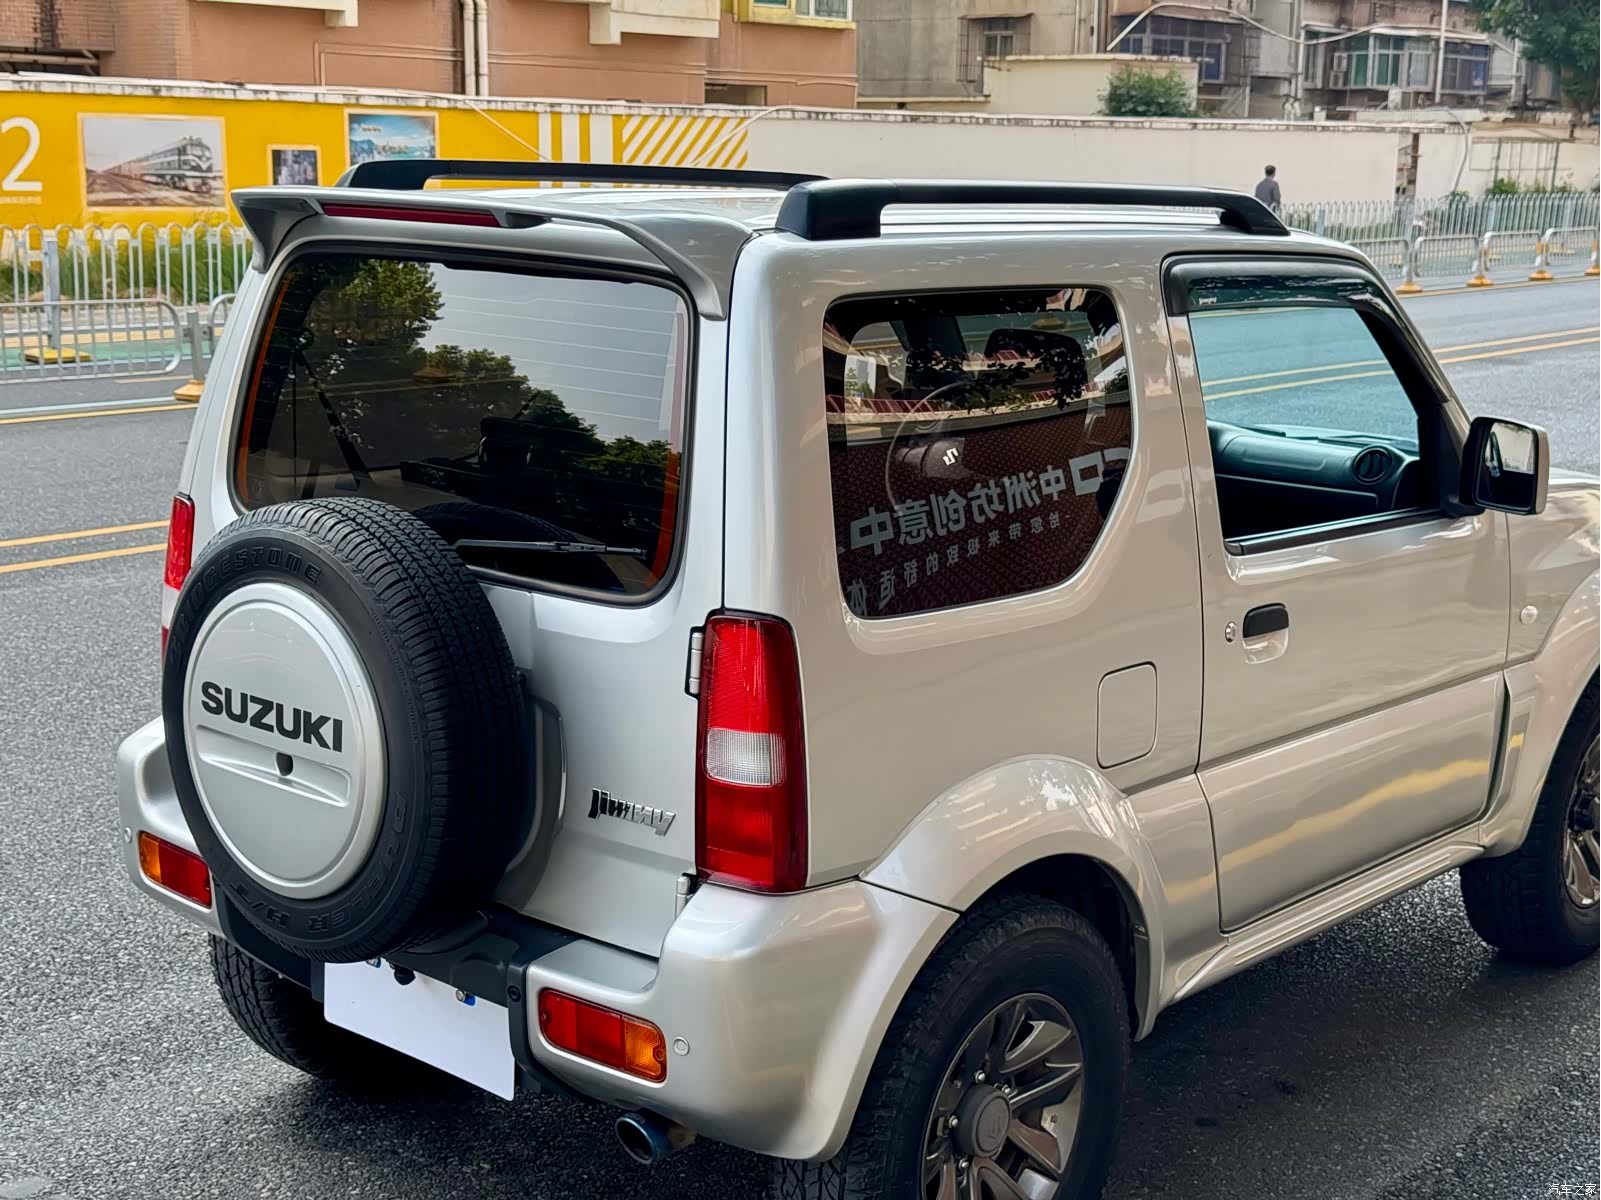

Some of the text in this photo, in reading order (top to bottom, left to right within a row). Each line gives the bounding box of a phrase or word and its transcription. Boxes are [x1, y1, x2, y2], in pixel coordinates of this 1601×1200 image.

[1, 116, 43, 192] 2
[200, 681, 344, 752] SUZUKI
[588, 788, 677, 836] Jimny
